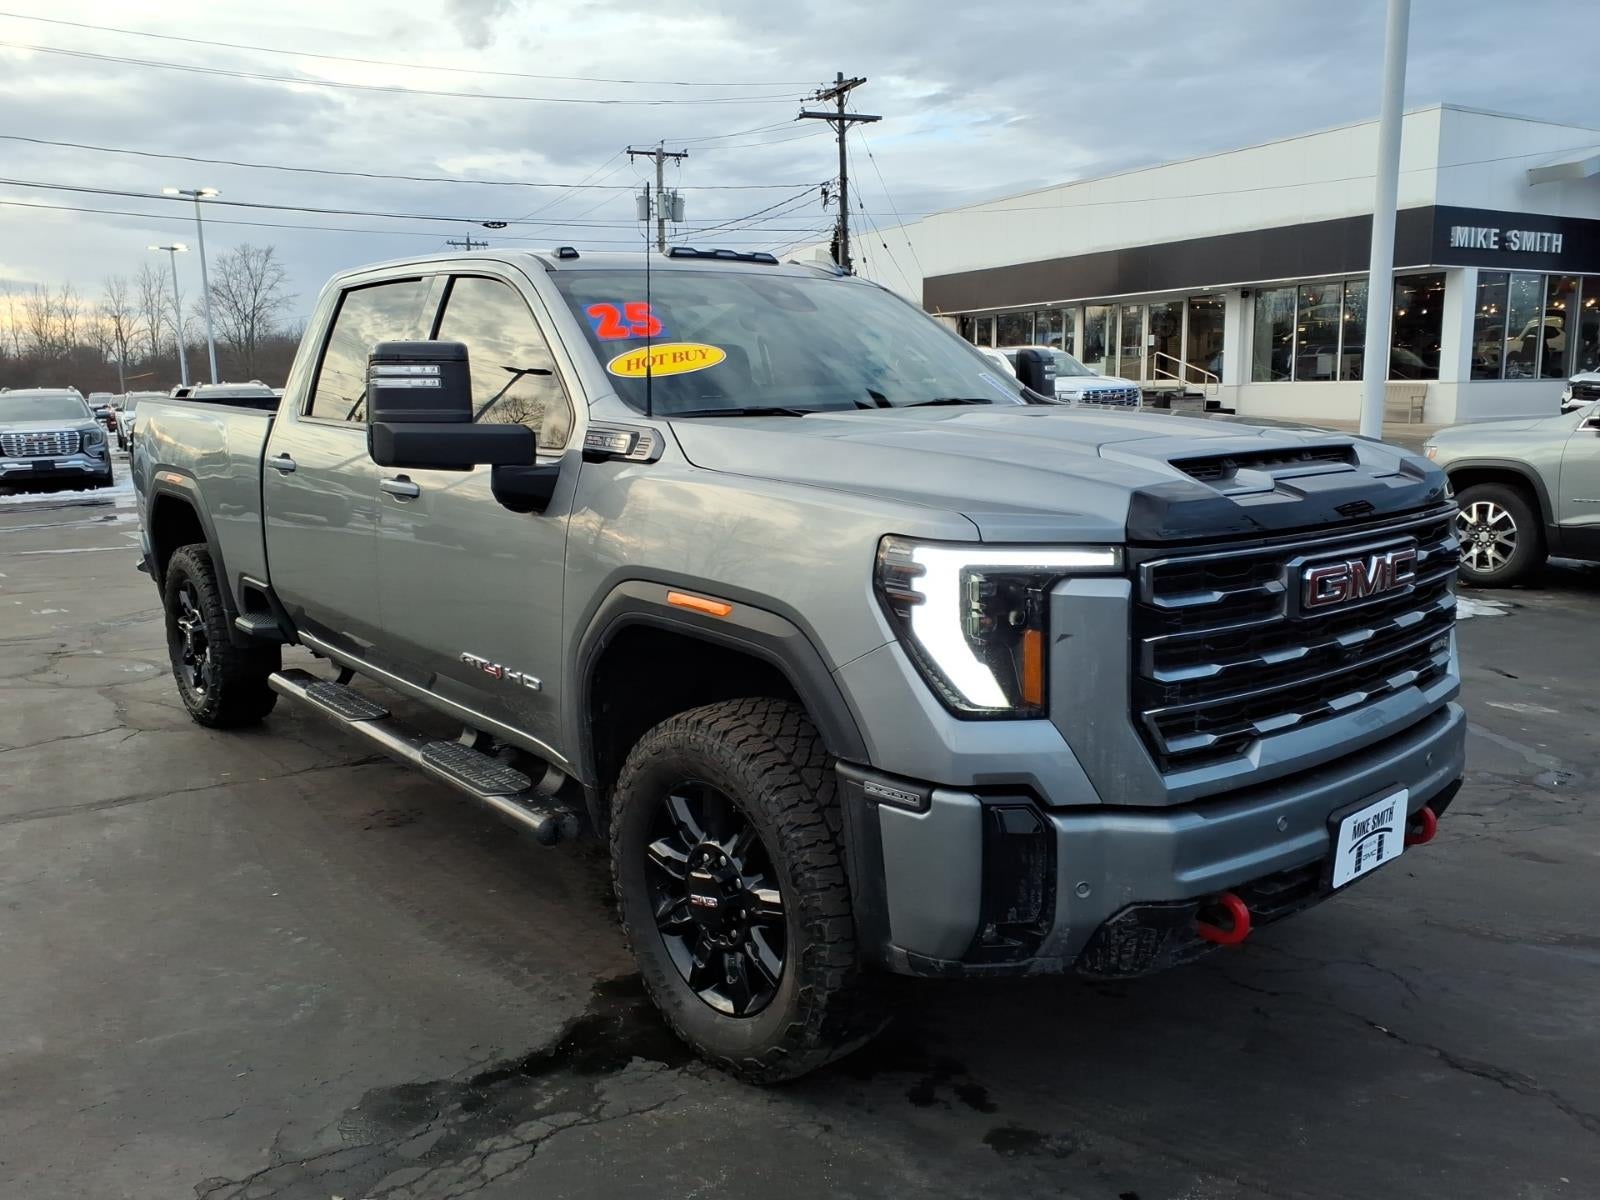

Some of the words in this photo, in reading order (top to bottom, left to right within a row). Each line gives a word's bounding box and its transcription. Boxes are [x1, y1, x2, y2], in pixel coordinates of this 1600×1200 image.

[1450, 226, 1499, 249] MIKE
[1506, 230, 1562, 254] SMITH
[587, 302, 662, 338] 25
[625, 353, 669, 371] HOT
[672, 348, 709, 363] BUY
[1304, 548, 1416, 608] GMC
[1352, 818, 1371, 841] MIKE
[1371, 806, 1394, 831] SMITH
